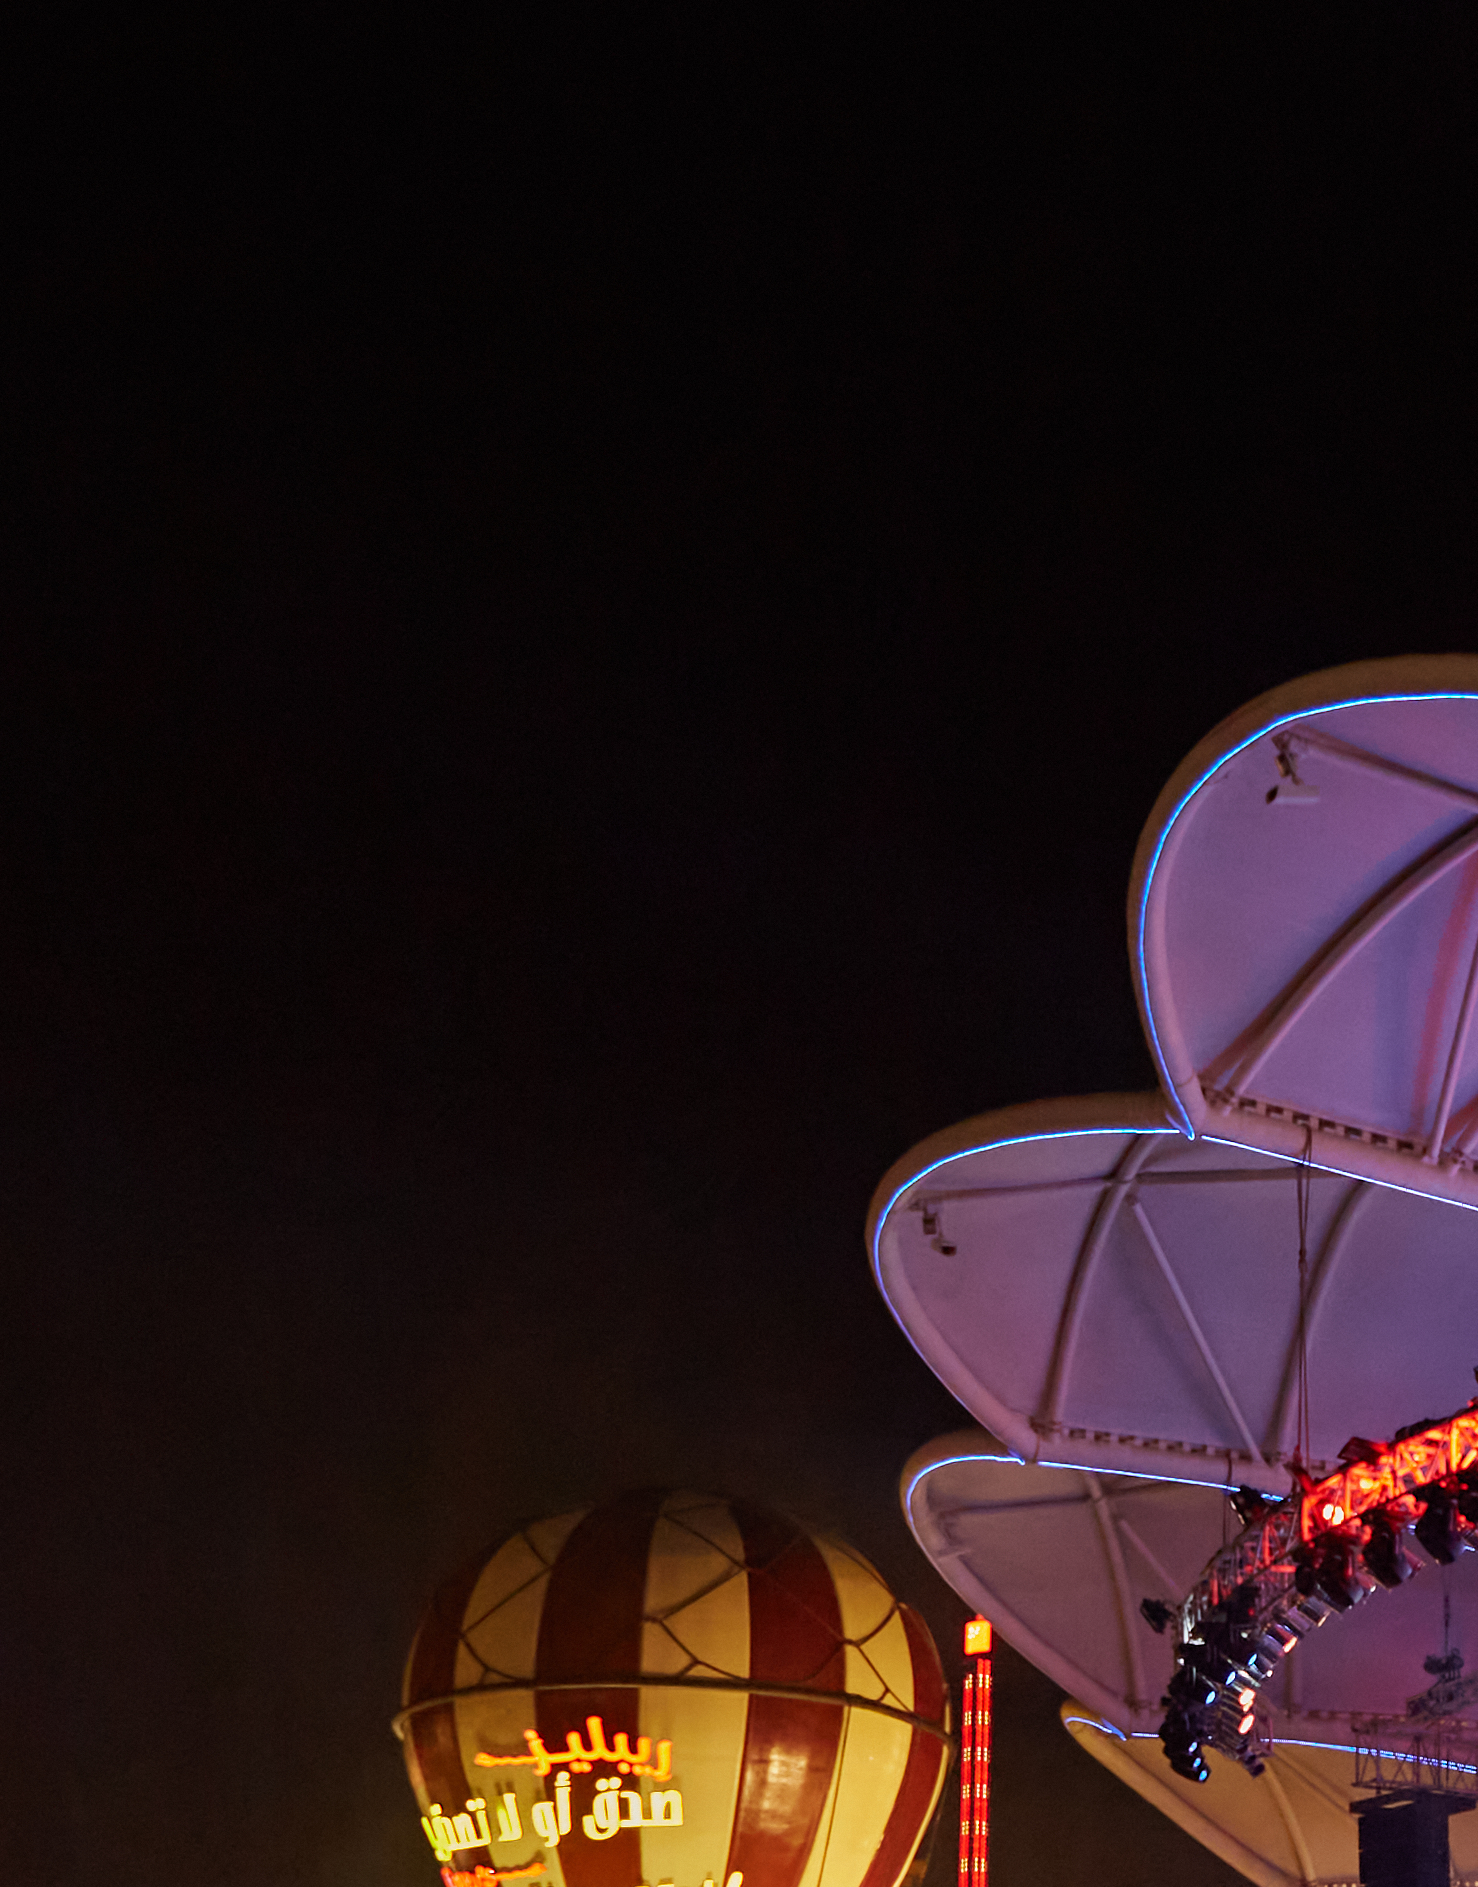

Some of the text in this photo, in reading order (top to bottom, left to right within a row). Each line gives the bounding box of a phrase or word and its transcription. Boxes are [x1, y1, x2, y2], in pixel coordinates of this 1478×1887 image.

[497, 1792, 522, 1842] لا
[531, 1771, 571, 1847] أو
[582, 1777, 683, 1840] صدق
